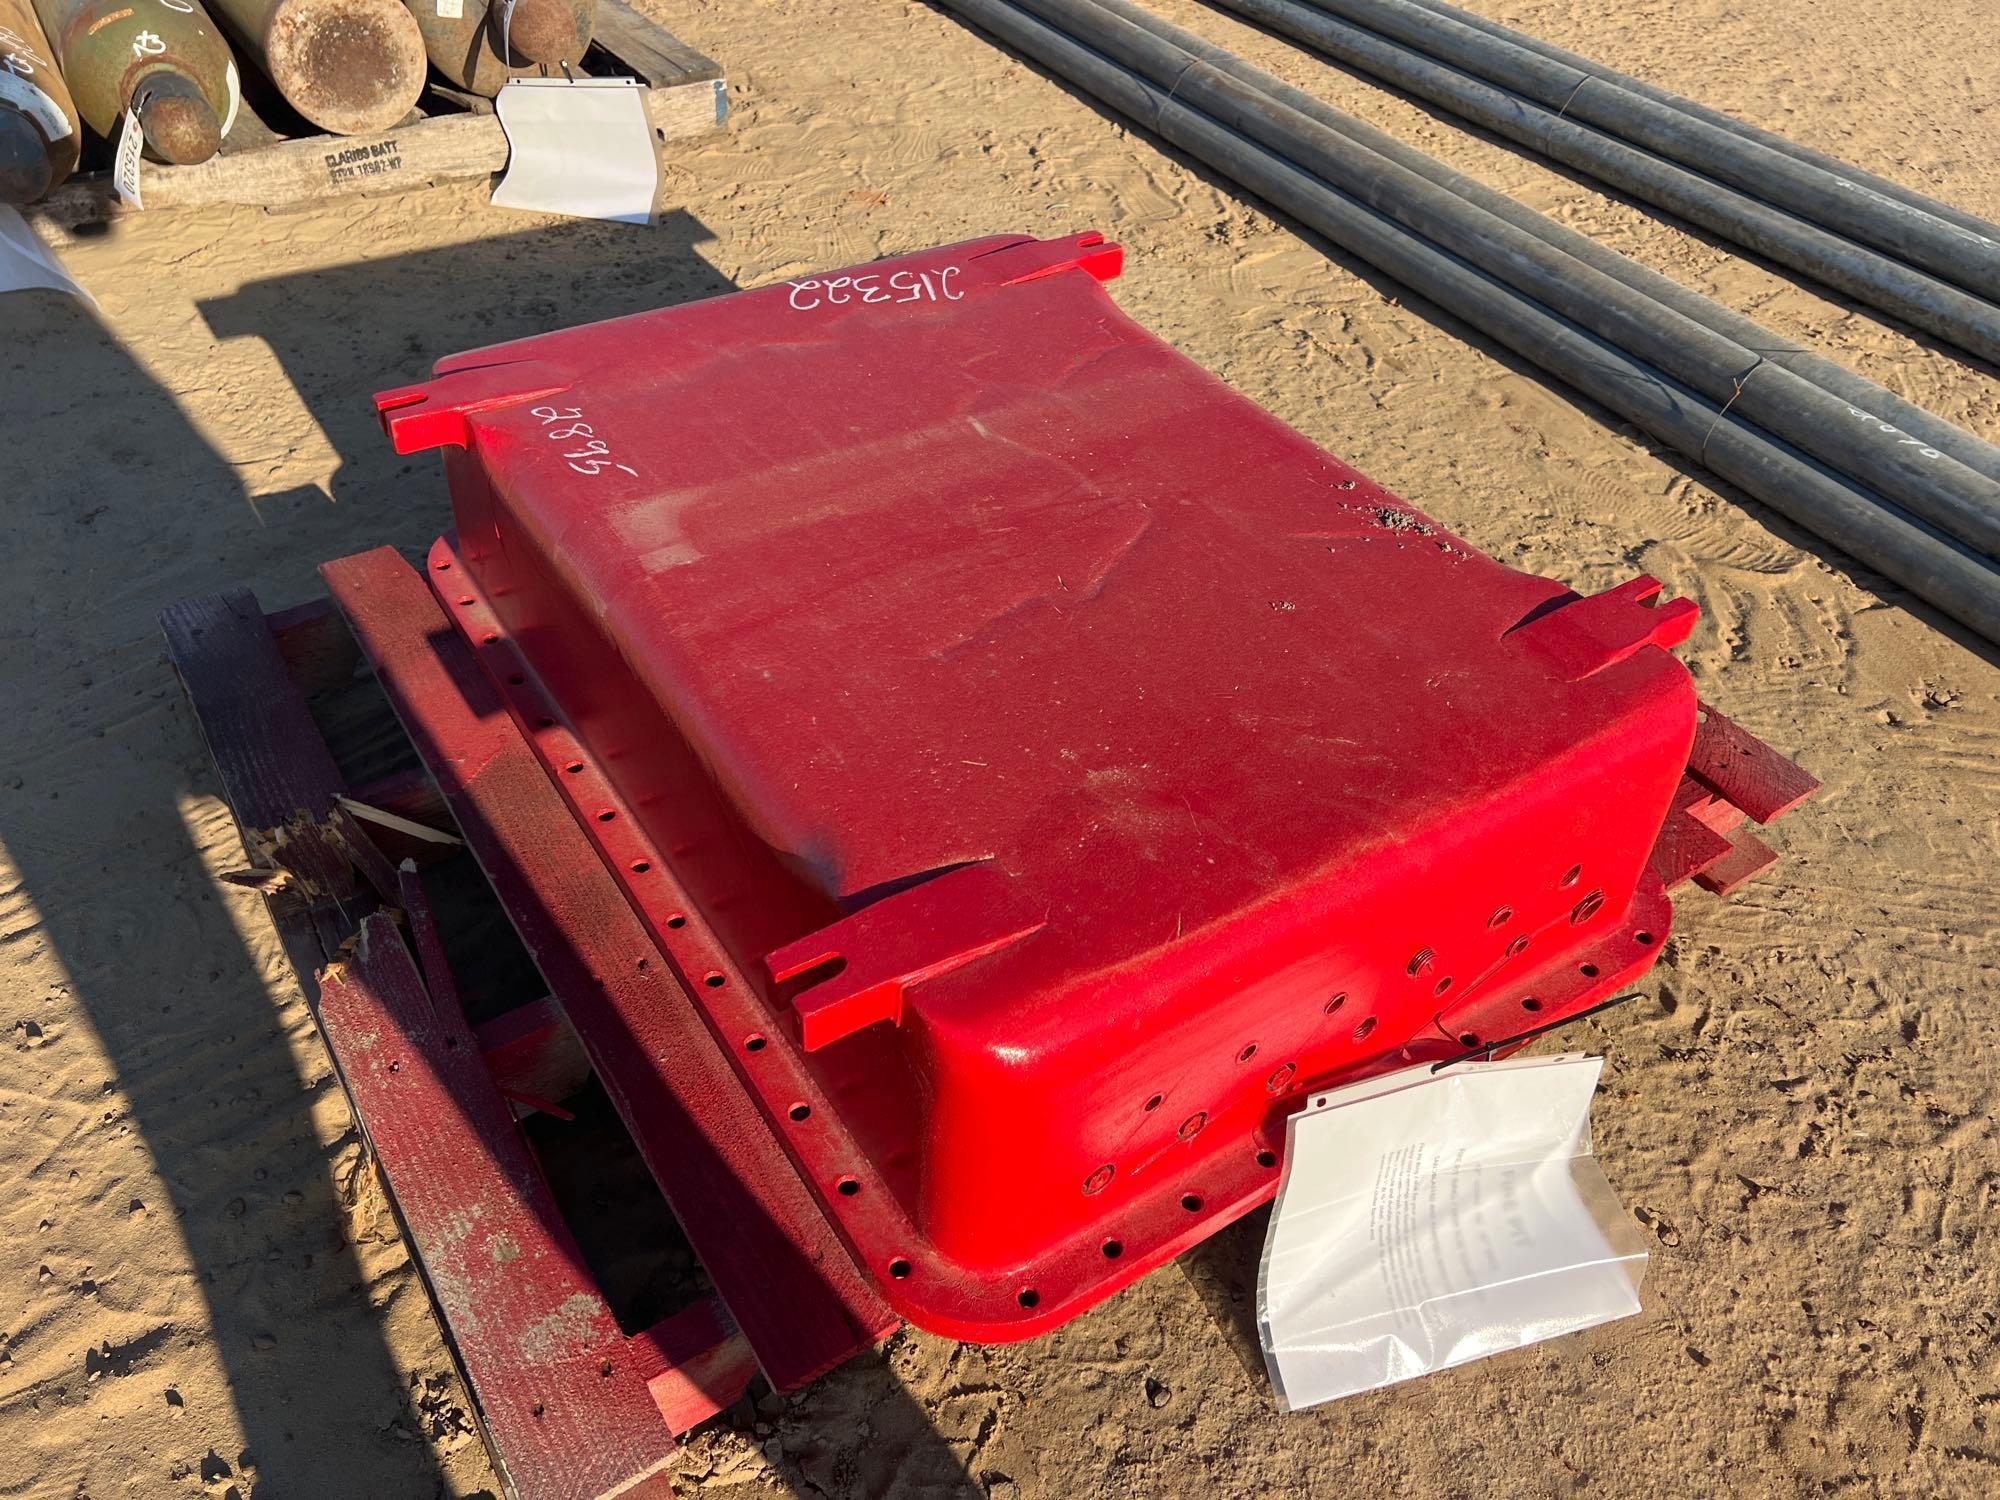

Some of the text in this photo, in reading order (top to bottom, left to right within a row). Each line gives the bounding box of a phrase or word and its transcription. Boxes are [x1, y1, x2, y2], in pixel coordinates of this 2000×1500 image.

[123, 134, 138, 195] 215320
[325, 140, 397, 168] CLARIOS BATT
[786, 266, 965, 311] 215322
